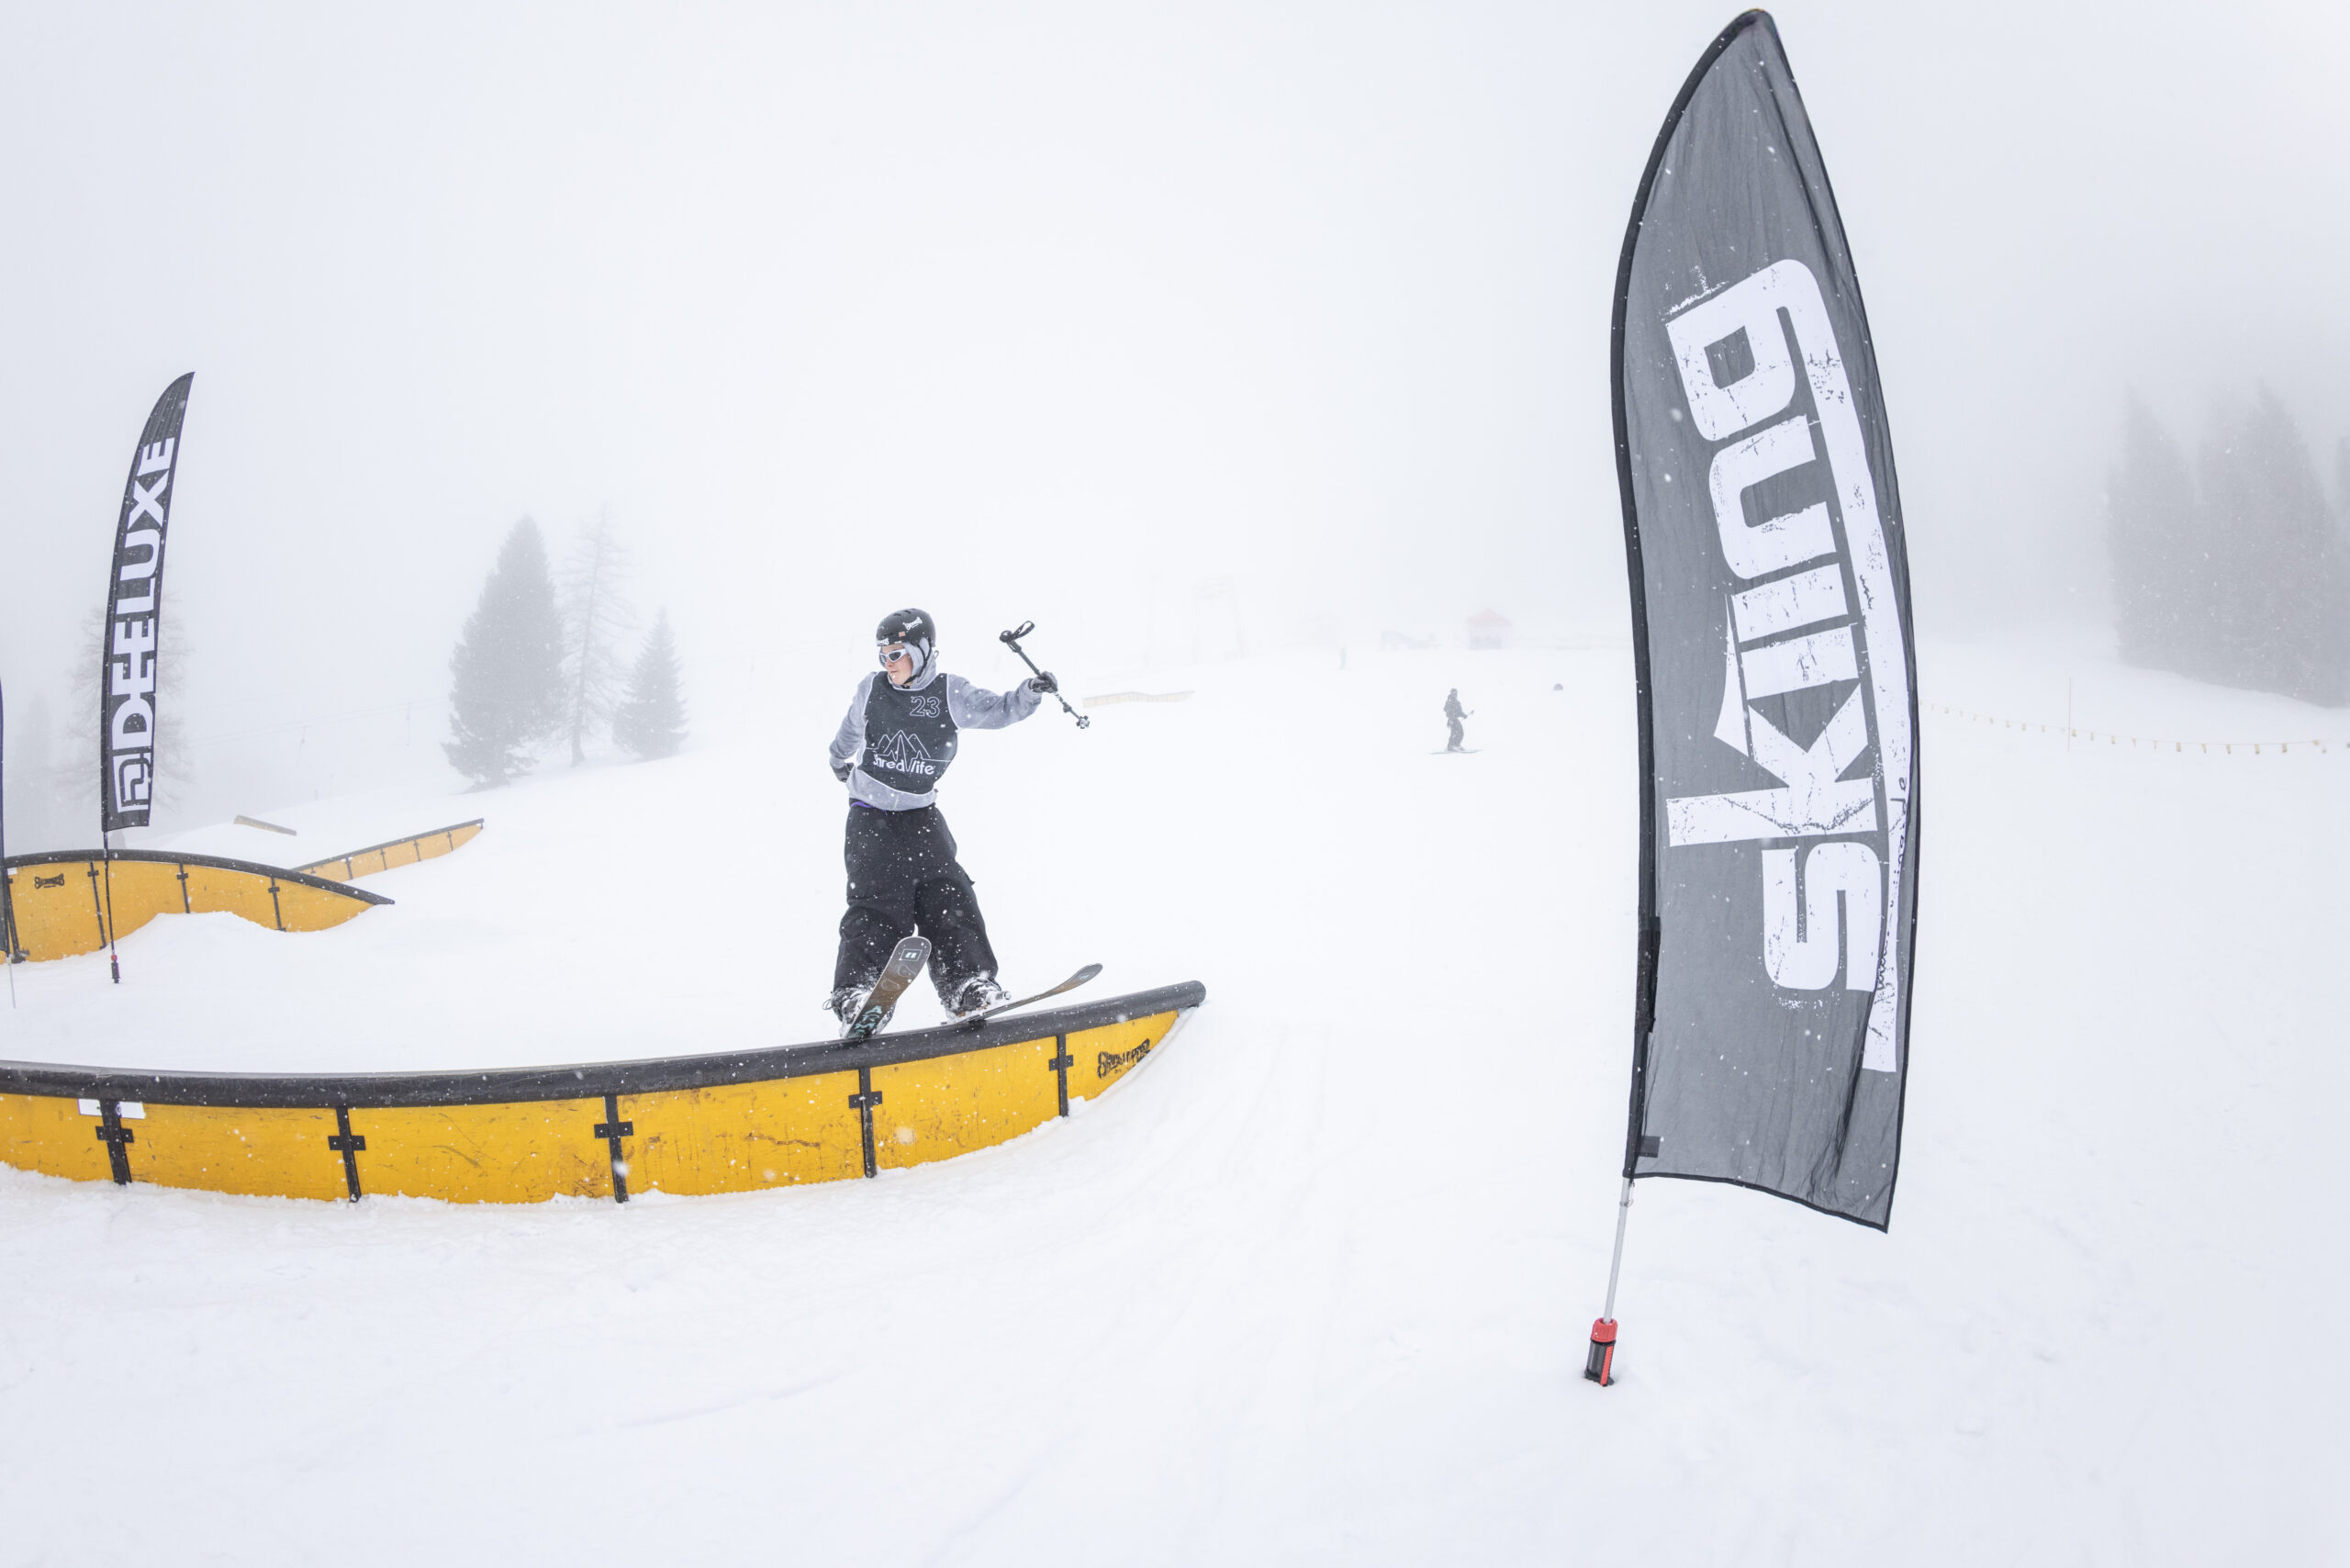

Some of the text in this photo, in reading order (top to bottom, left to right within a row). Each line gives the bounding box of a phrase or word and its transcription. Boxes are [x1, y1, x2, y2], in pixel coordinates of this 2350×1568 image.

[111, 437, 174, 751] DEELUXE
[909, 695, 941, 718] 23
[1664, 258, 1911, 1073] skiing
